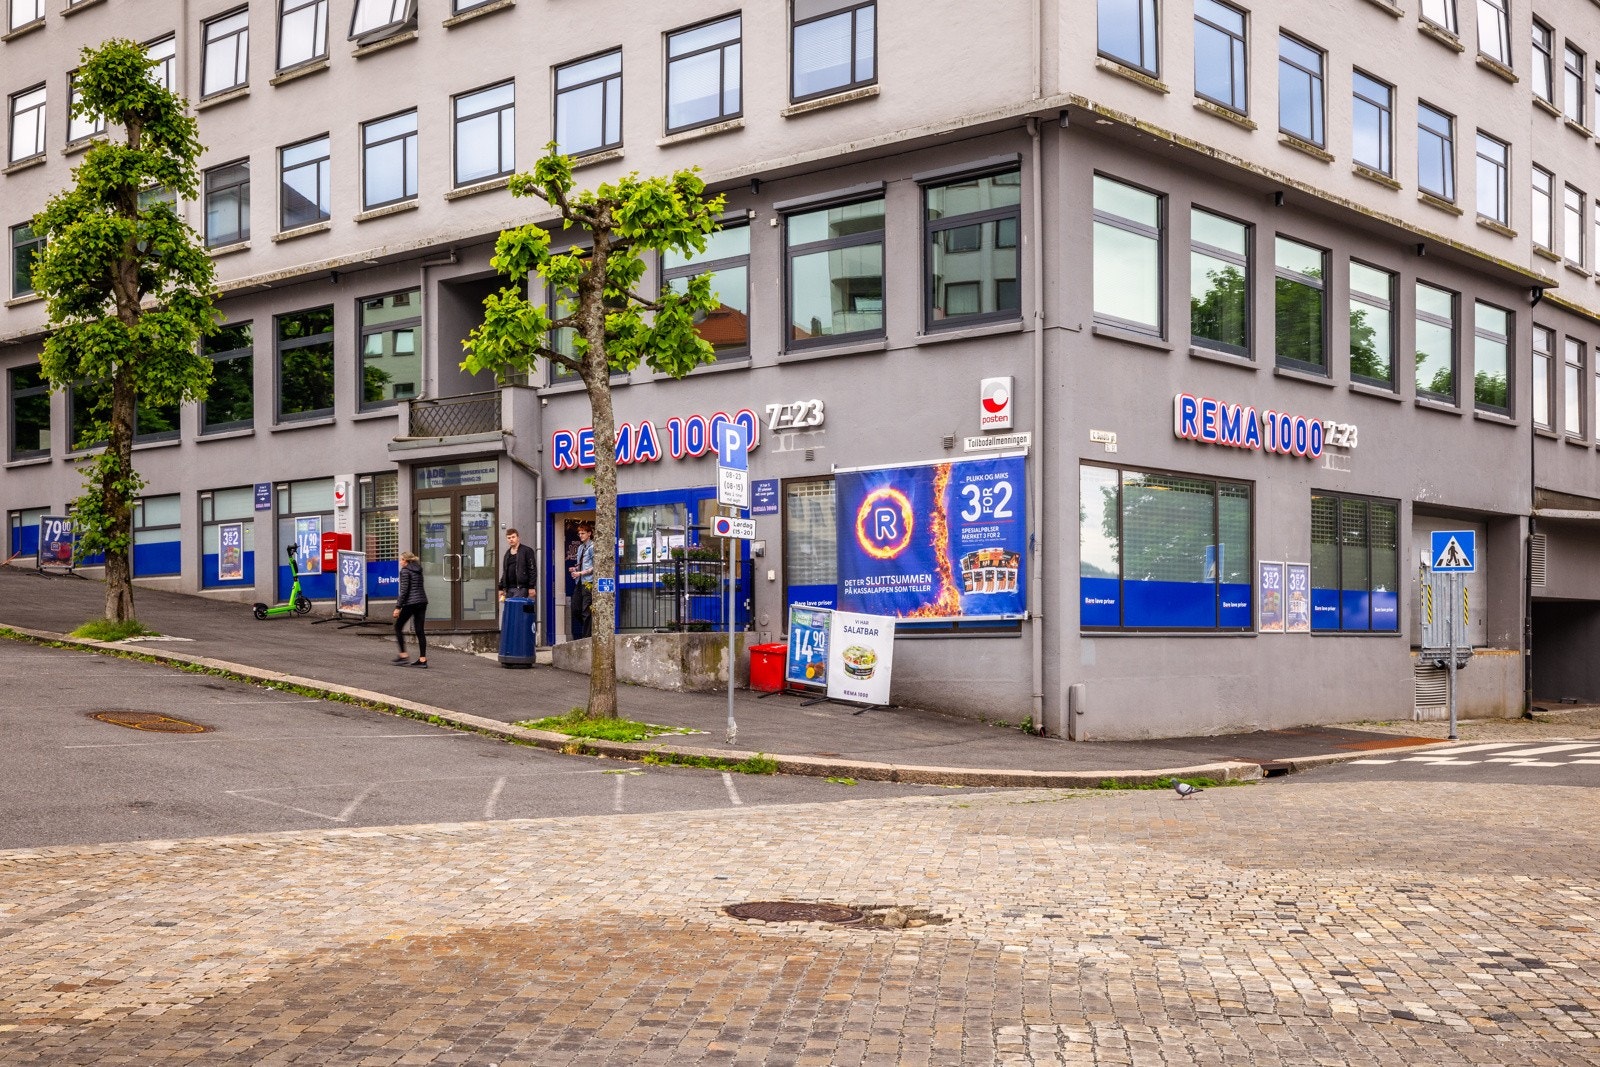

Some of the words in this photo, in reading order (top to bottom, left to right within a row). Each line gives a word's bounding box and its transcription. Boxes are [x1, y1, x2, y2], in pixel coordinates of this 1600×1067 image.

[766, 400, 825, 430] 7-23
[982, 415, 1009, 425] posten
[1175, 393, 1261, 450] REMA
[1263, 409, 1323, 459] 1000
[725, 429, 741, 462] P
[968, 435, 1028, 448] Tollbodallmenningen
[966, 474, 984, 482] PLUKK
[961, 484, 981, 522] 3
[982, 487, 993, 514] FOR
[993, 481, 1013, 518] 2
[45, 520, 62, 541] 79
[733, 521, 753, 529] Lørdag
[875, 508, 897, 540] R
[223, 531, 229, 546] 3
[233, 531, 239, 545] 2
[342, 559, 349, 575] 3
[354, 561, 360, 576] 2
[844, 579, 857, 587] DET
[865, 574, 932, 586] SLUTTSUMMEN
[1263, 572, 1268, 589] 3
[1273, 572, 1279, 589] 2
[1290, 573, 1295, 590] 3
[1300, 574, 1306, 591] 2
[844, 587, 853, 595] PÅ
[853, 586, 894, 594] KASSALAPPEN
[894, 585, 908, 593] SOM
[908, 584, 931, 592] TELLER
[843, 625, 879, 637] SALATBAR
[795, 629, 813, 663] 14
